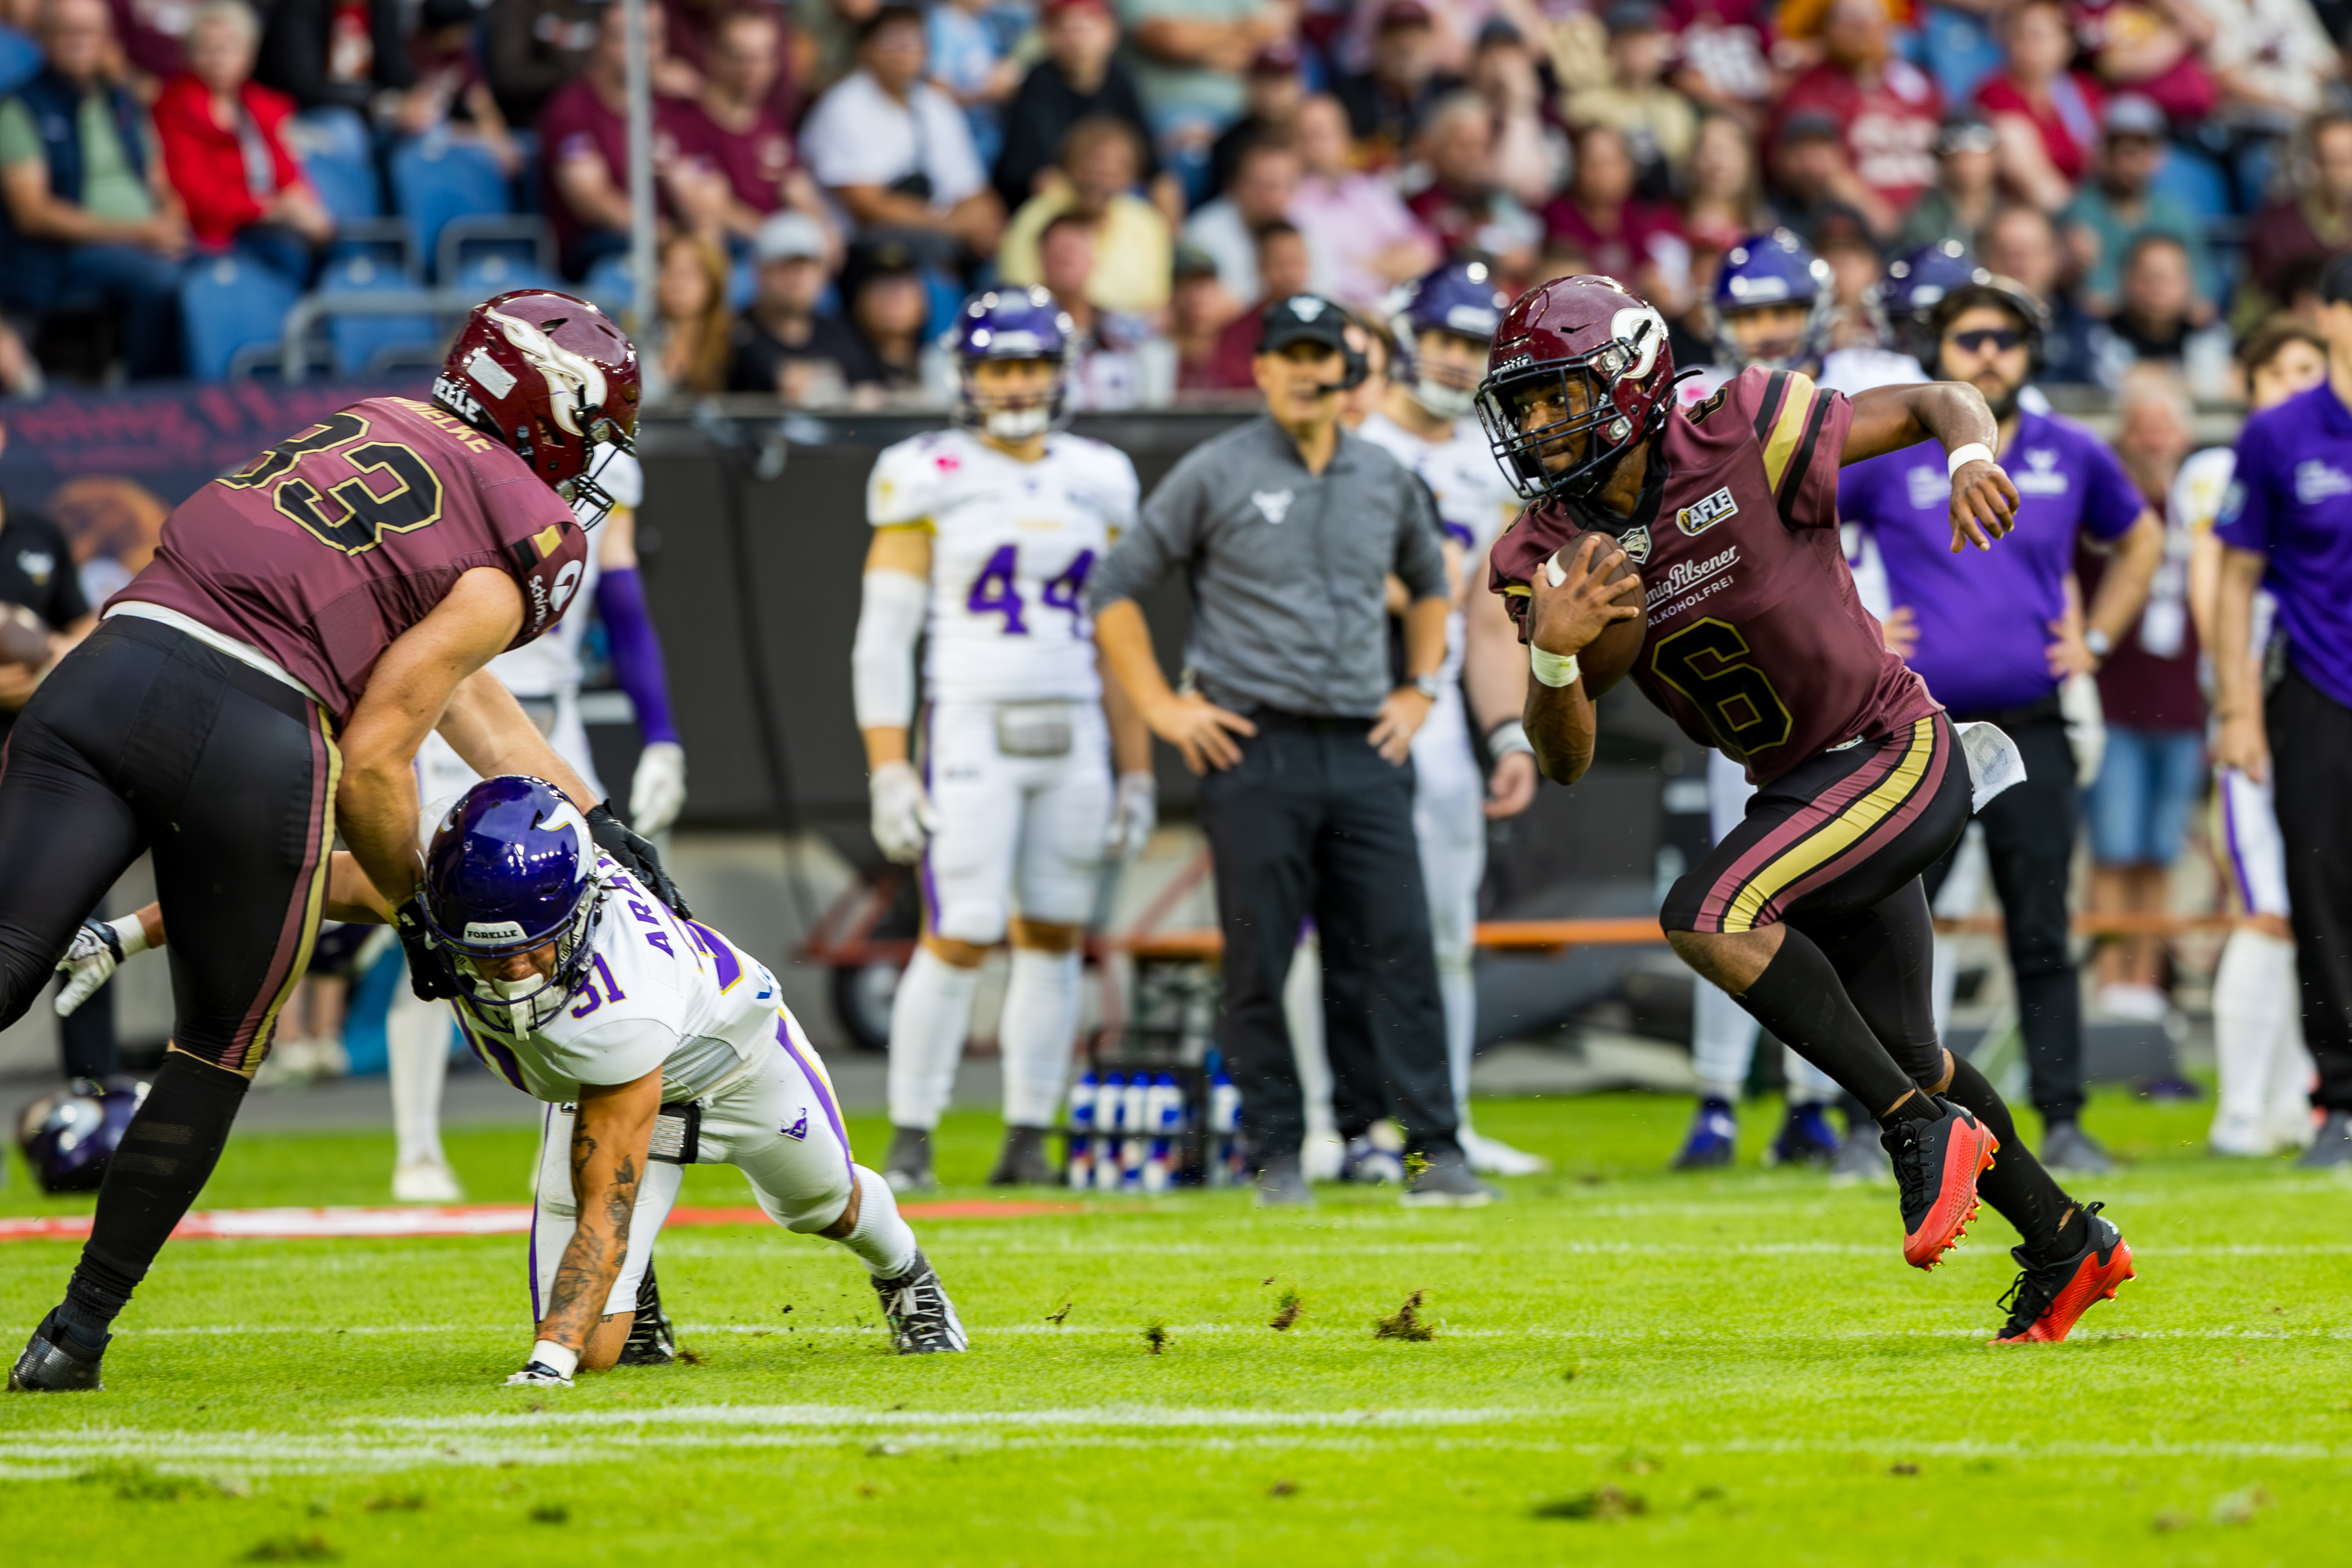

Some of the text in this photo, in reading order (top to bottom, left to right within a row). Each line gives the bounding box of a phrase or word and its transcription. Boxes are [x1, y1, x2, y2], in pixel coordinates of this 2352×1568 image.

[432, 377, 481, 423] ELLE
[1689, 490, 1732, 530] AFLE
[967, 544, 1094, 638] 44
[1648, 575, 1735, 629] ALKOHOLFREI
[1650, 616, 1794, 756] 6
[467, 929, 518, 939] FORELLE
